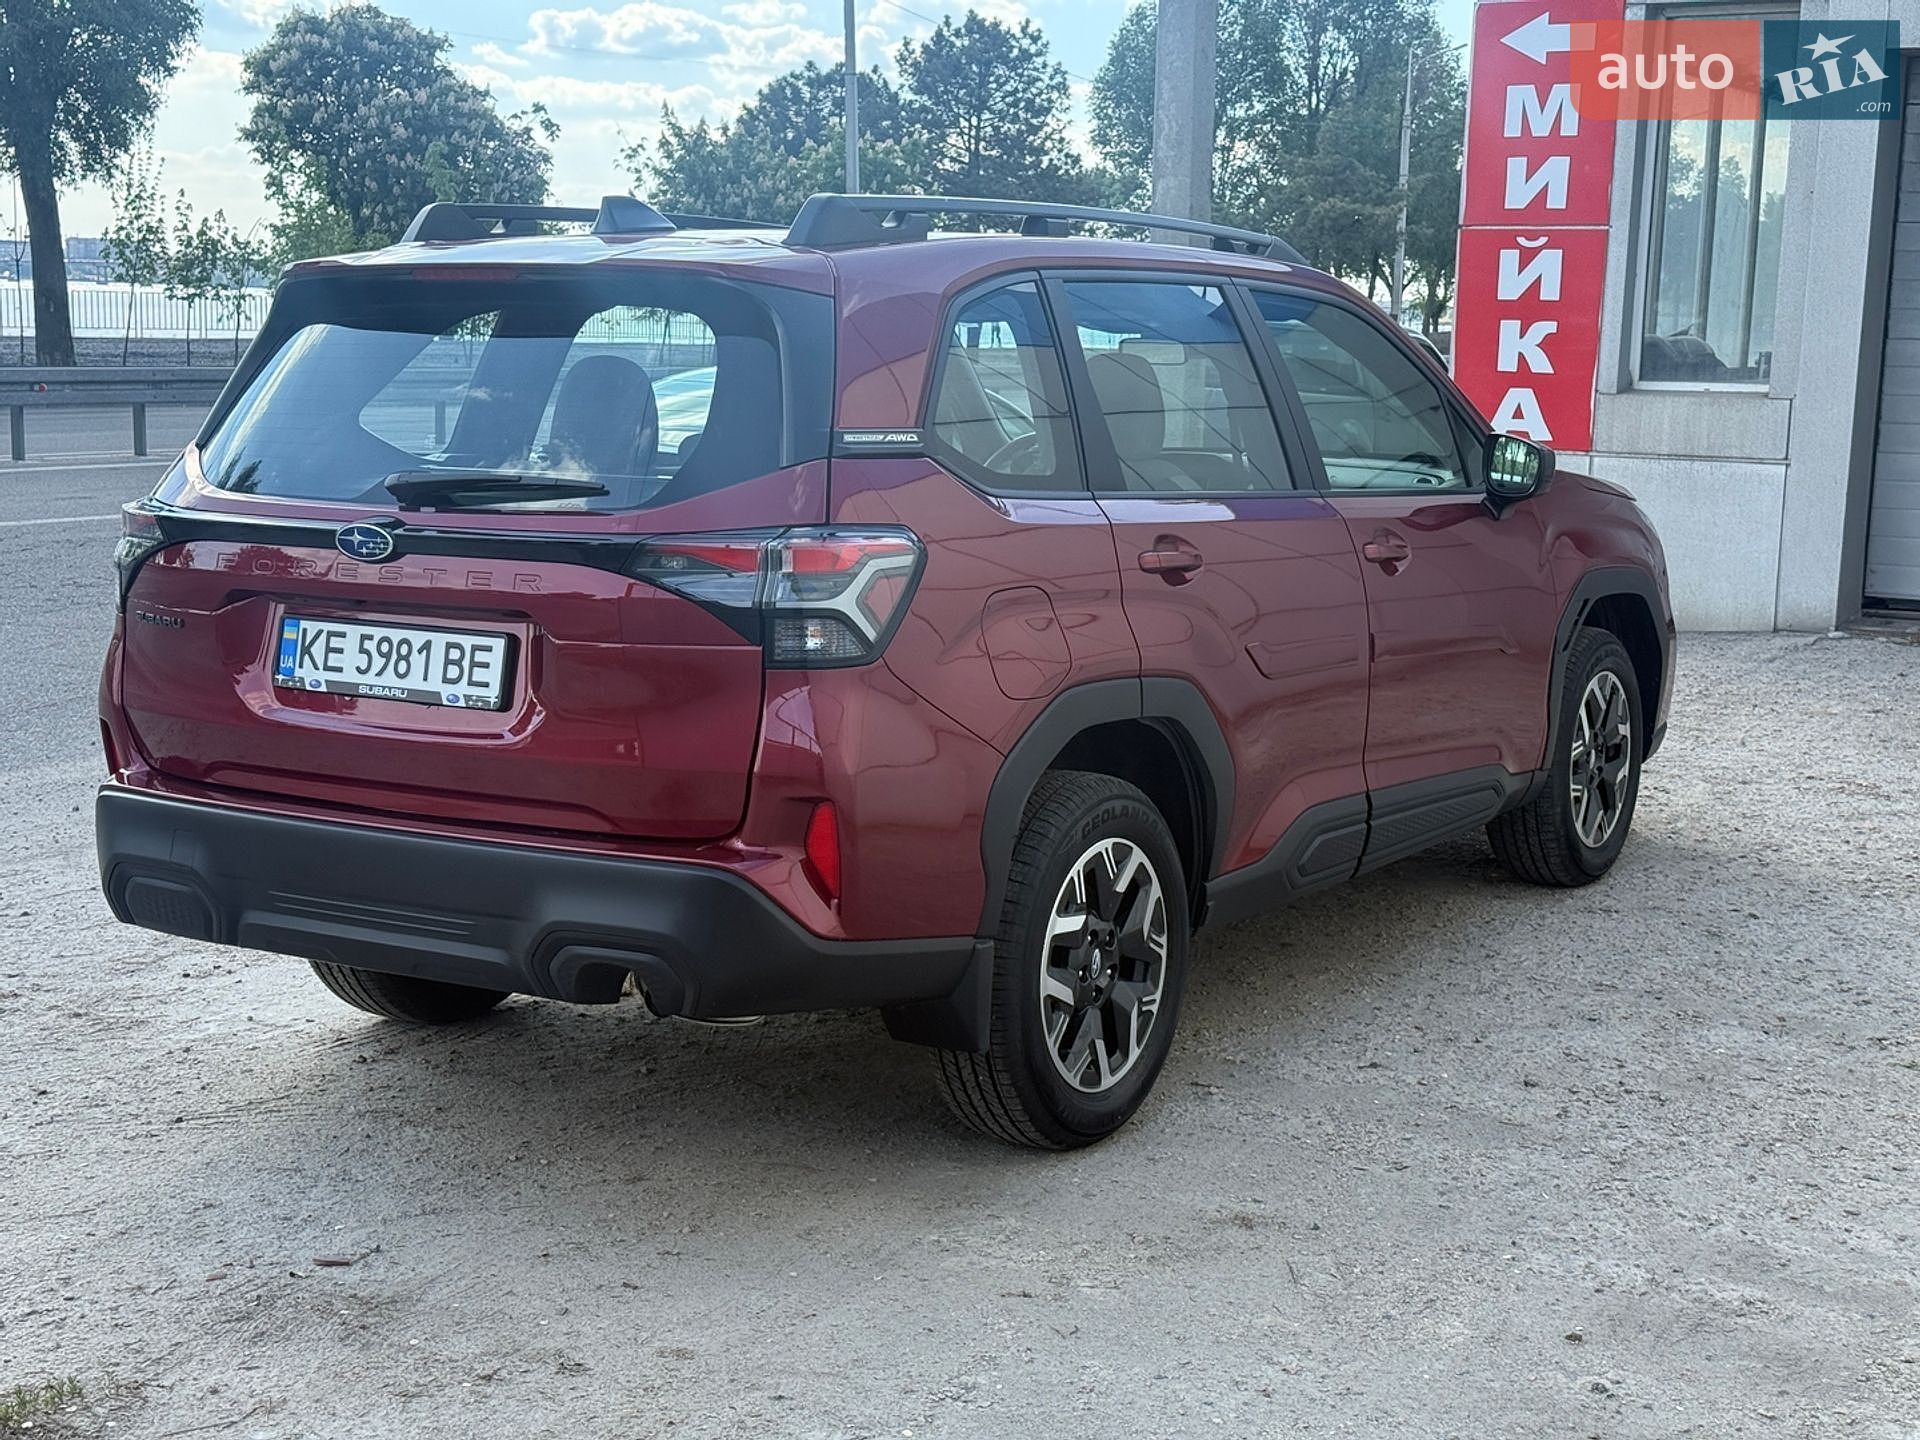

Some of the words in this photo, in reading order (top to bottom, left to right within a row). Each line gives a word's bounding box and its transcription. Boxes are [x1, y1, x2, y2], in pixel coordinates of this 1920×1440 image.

[1490, 83, 1581, 441] МИЙКА
[884, 433, 919, 441] AWD
[215, 551, 543, 592] FORESTER
[280, 655, 294, 668] UA
[298, 627, 347, 673] KE
[355, 633, 433, 682] 5981
[441, 641, 493, 688] BE
[358, 685, 408, 698] SUBARU
